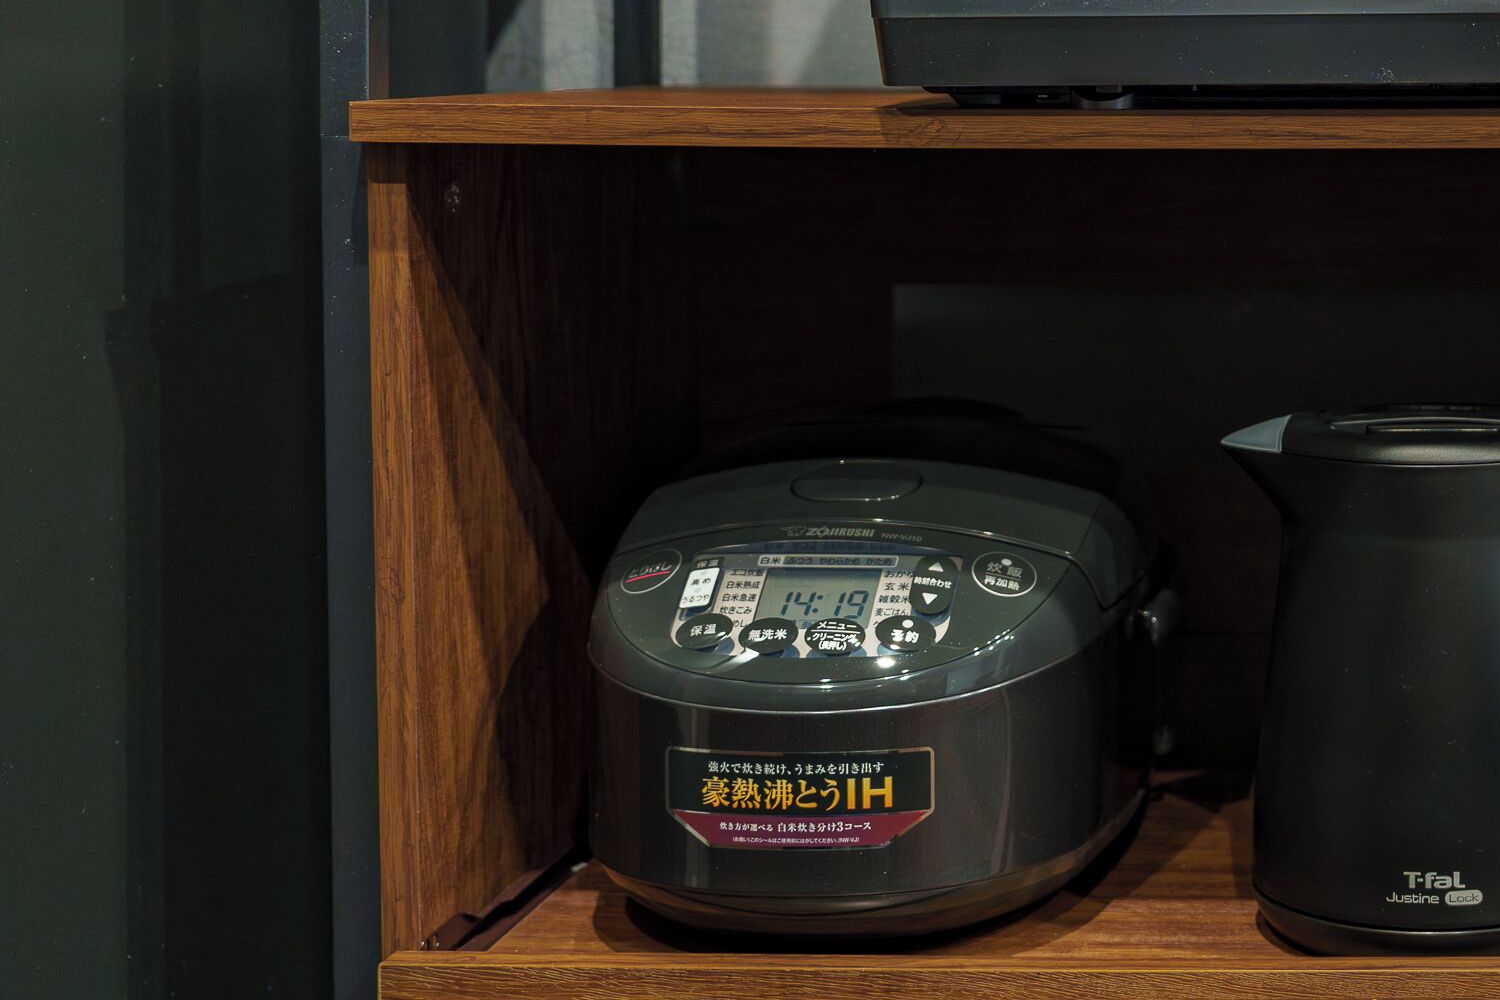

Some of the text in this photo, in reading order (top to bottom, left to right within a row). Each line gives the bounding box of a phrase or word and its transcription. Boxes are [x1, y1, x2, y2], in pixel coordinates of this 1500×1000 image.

[805, 525, 875, 538] ZOJIRUSHI
[781, 590, 870, 619] 14:19
[690, 623, 717, 637] 保温
[816, 621, 857, 630] メニュー
[701, 775, 894, 811] 豪熱沸とうIH
[1386, 892, 1480, 904] Justine Lock
